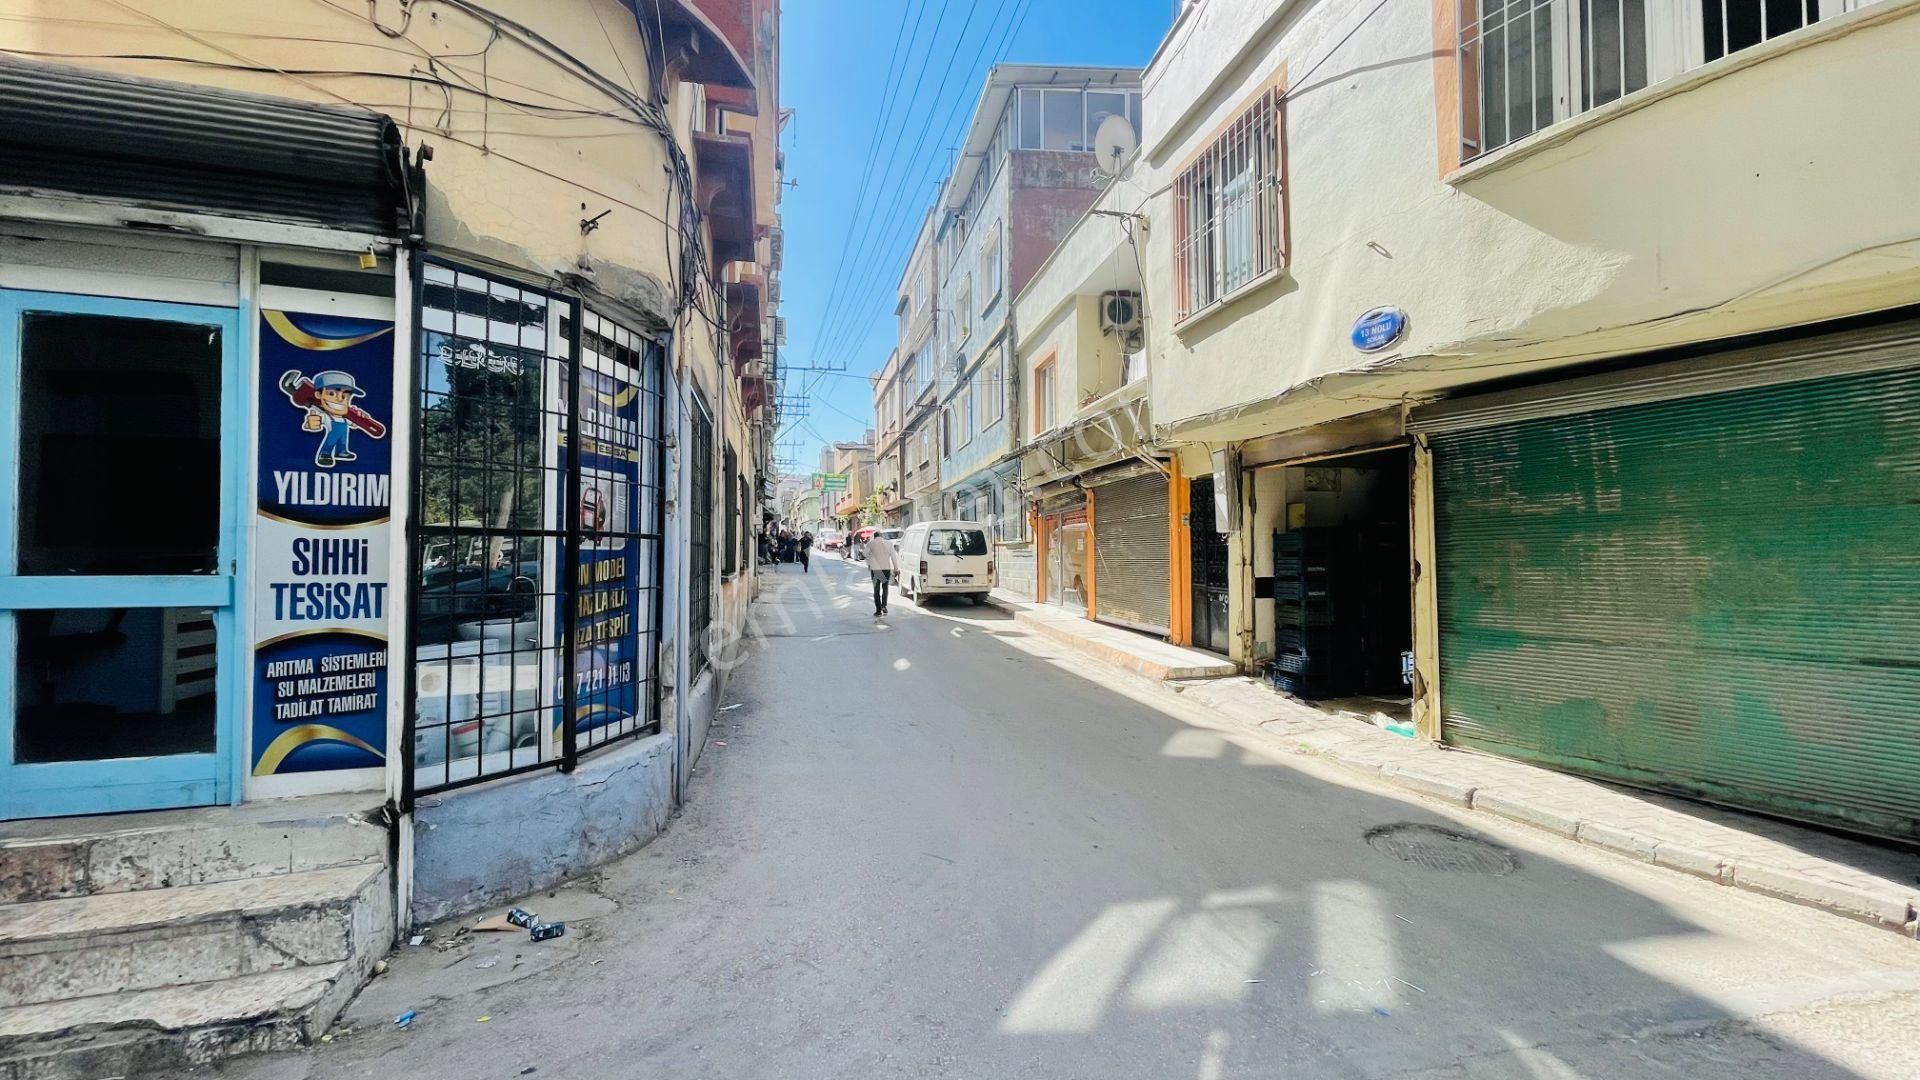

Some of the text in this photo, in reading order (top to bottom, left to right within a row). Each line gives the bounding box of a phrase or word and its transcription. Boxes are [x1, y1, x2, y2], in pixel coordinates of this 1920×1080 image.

[1371, 321, 1391, 334] NOLU
[273, 470, 389, 507] YILDIRIM
[266, 648, 387, 678] ARITMA SİSTEMLERİ
[278, 670, 376, 698] SU MALZEMELERİ
[275, 693, 378, 719] TADİLAT TAMİRAT
